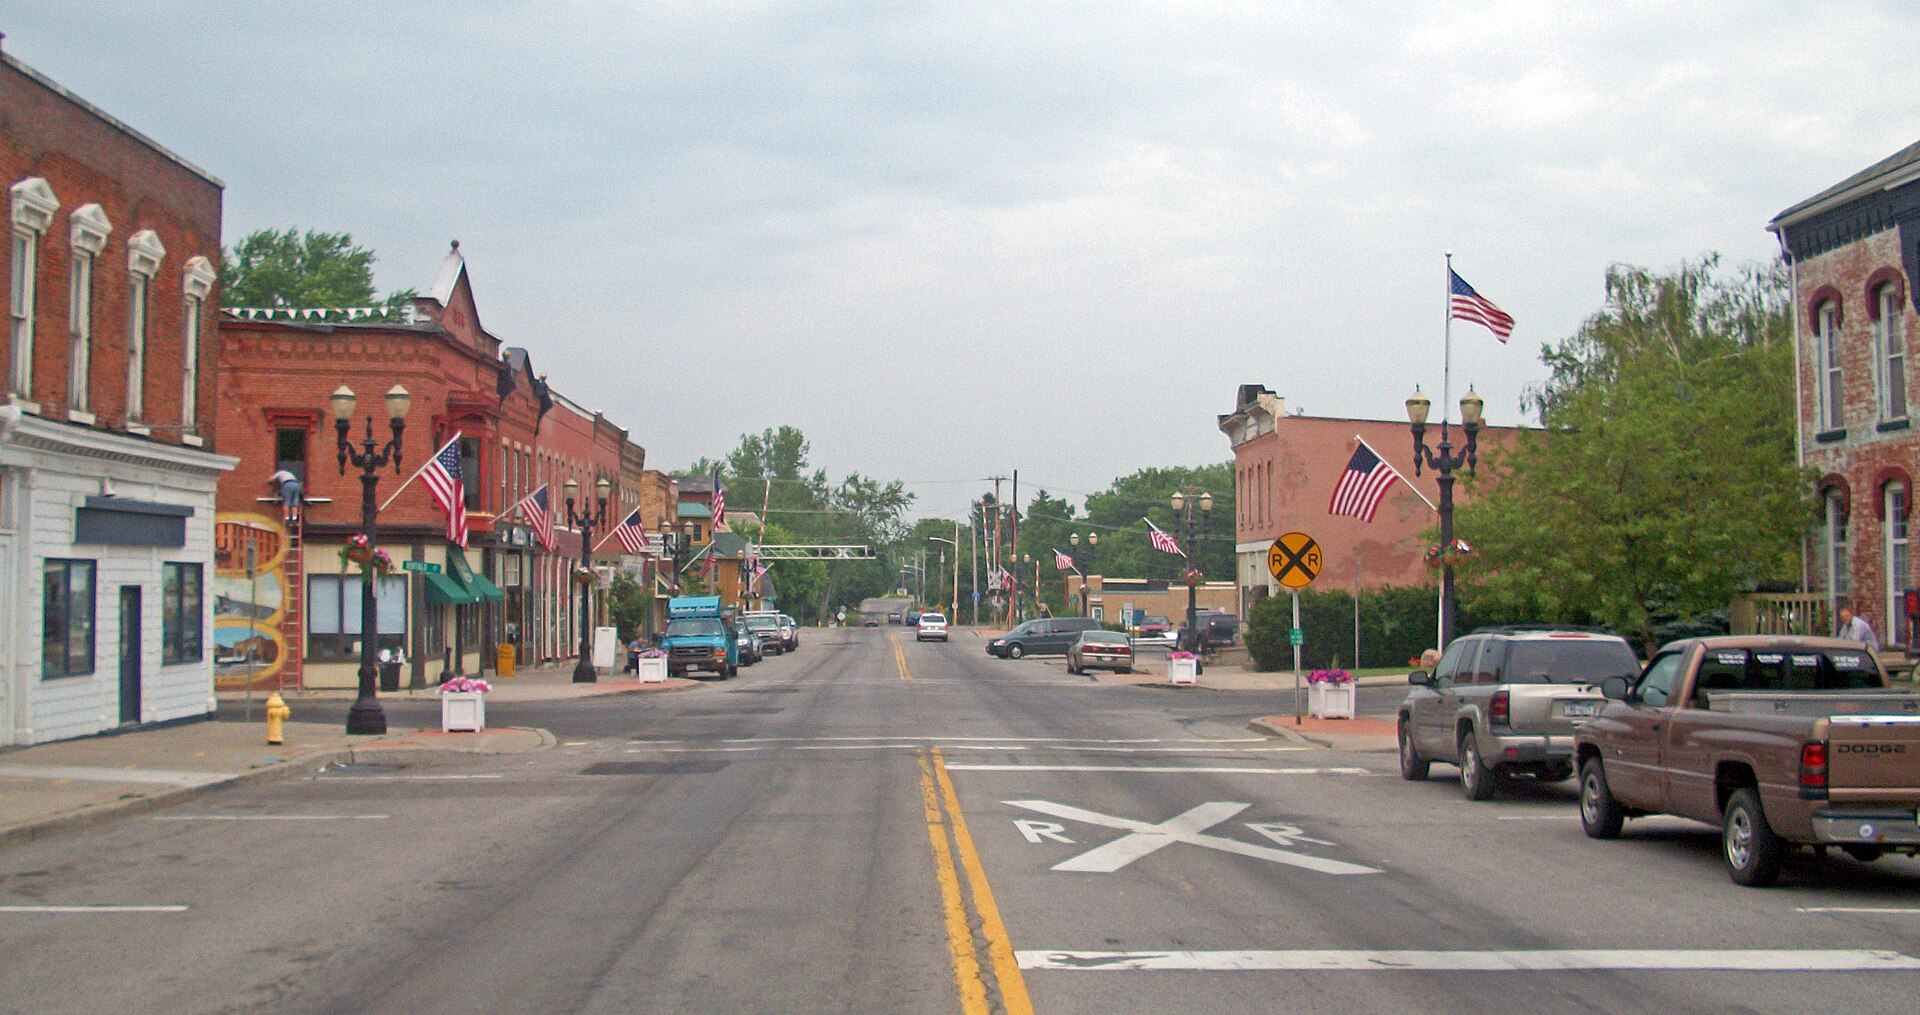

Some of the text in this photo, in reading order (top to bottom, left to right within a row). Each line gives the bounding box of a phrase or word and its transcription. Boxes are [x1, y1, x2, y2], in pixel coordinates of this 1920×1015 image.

[1272, 553, 1319, 567] R R
[1837, 744, 1906, 754] DODGE
[1013, 820, 1338, 846] R R
